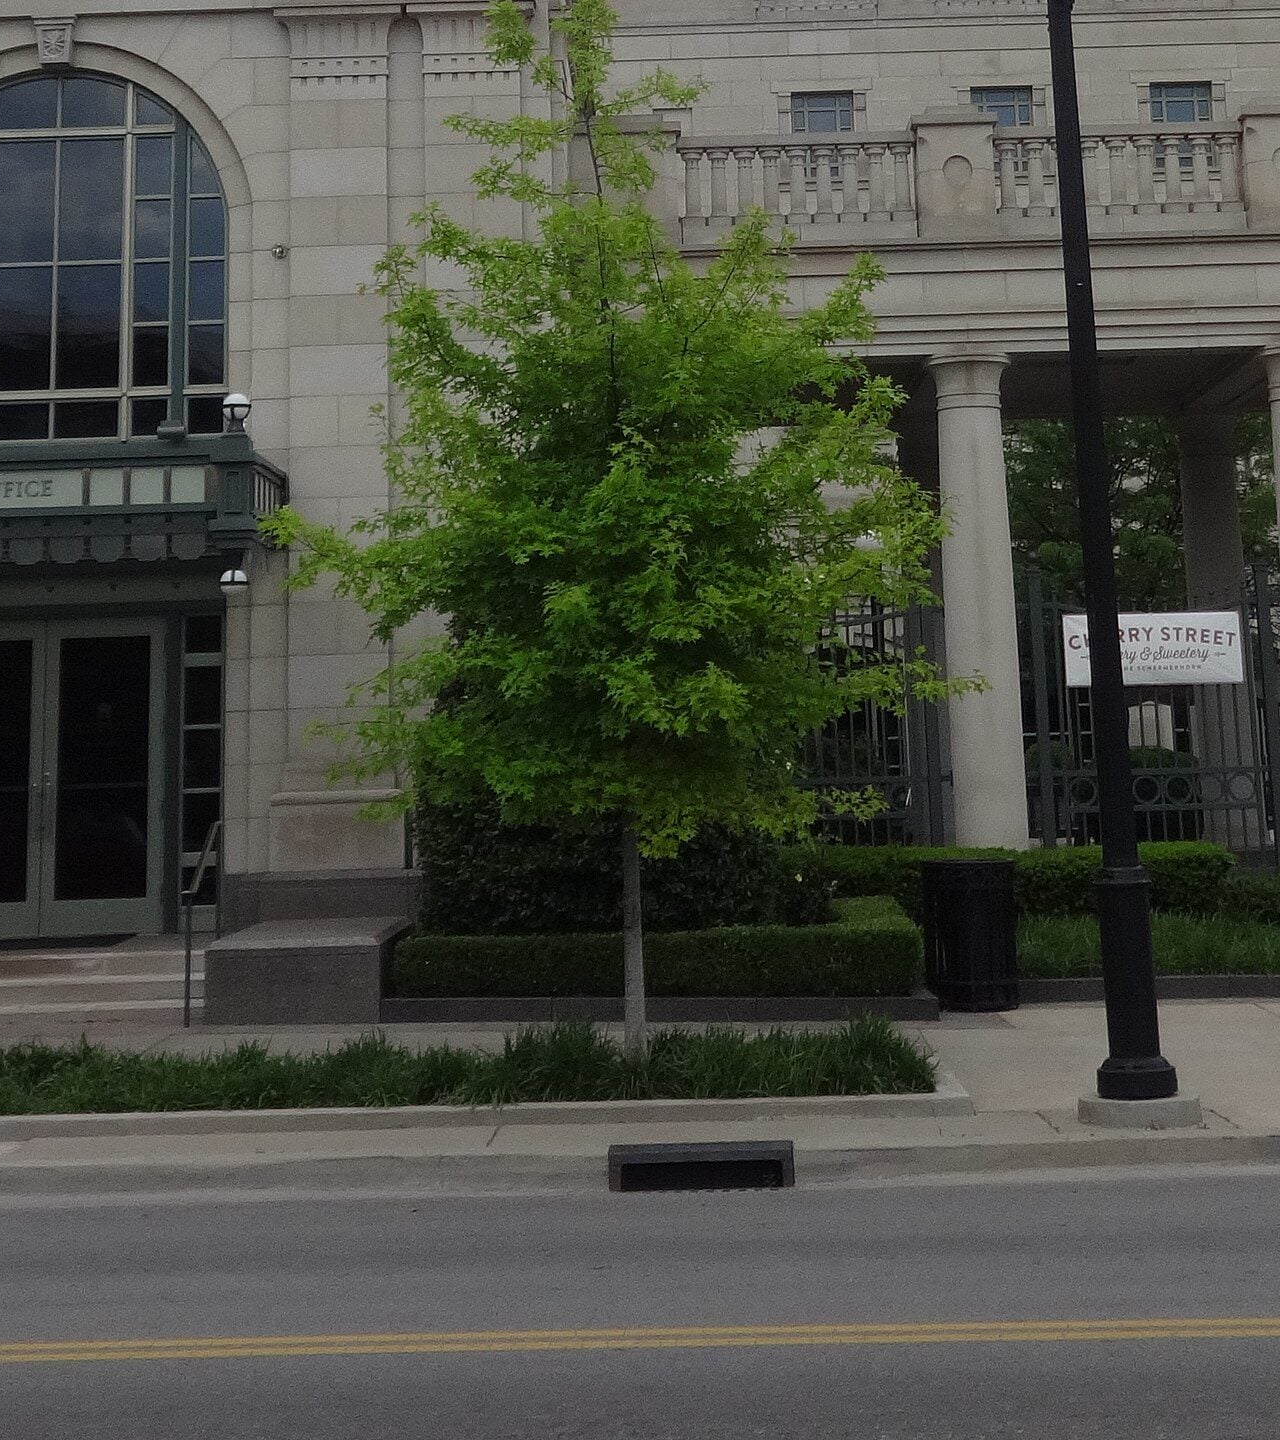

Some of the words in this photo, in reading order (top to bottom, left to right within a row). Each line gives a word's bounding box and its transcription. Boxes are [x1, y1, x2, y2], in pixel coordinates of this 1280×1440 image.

[1068, 627, 1153, 649] CRRY
[1160, 626, 1236, 647] STREET
[1140, 646, 1152, 661] &
[1153, 646, 1210, 662] Sweetery
